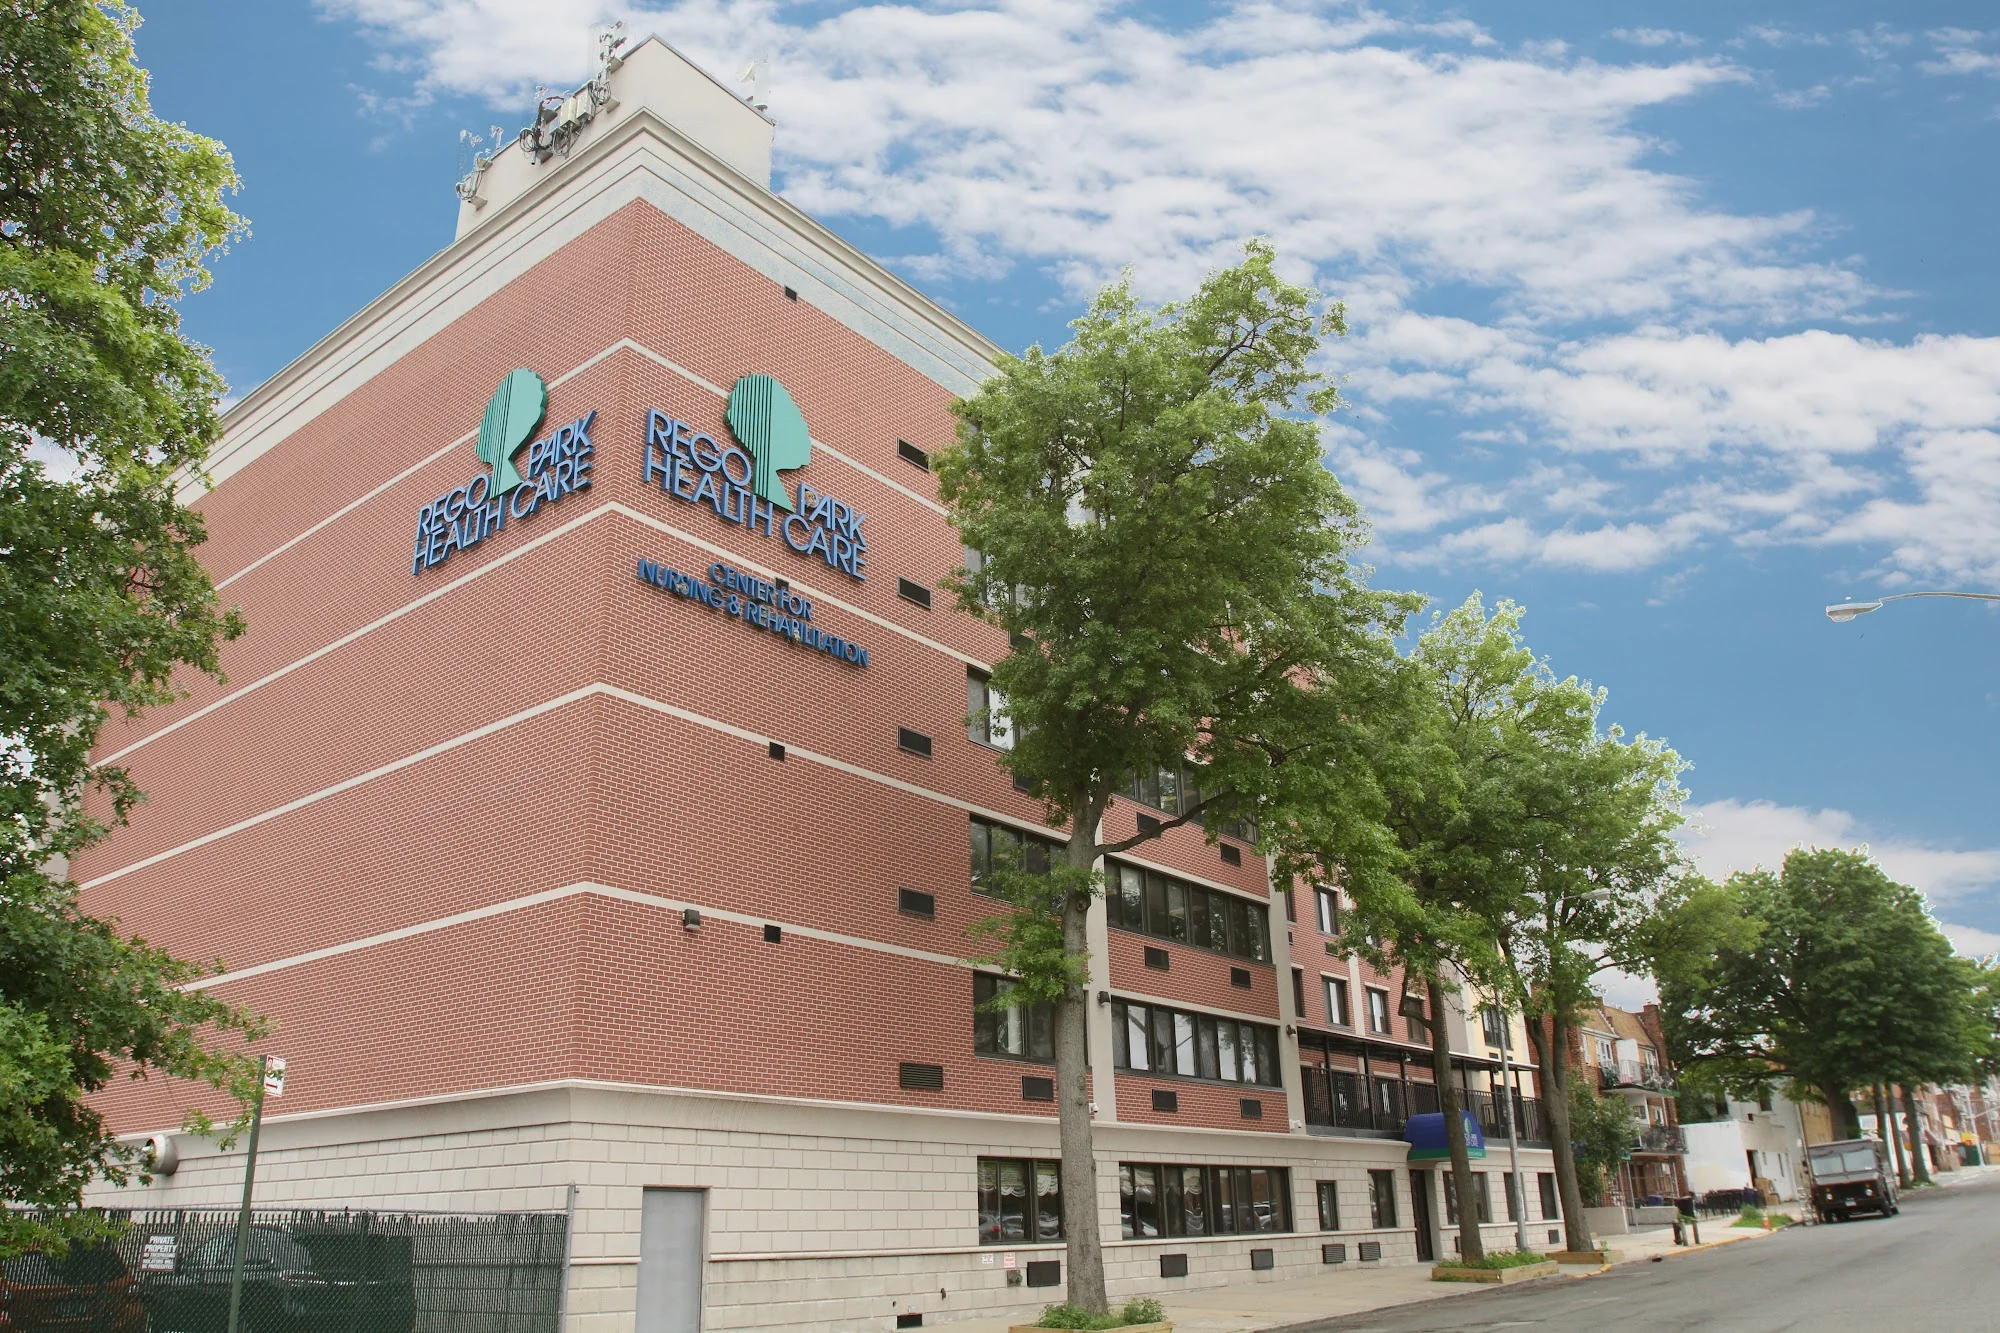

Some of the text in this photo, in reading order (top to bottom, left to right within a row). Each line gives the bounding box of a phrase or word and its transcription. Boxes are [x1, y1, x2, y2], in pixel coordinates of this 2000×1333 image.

[412, 446, 594, 576] HEALTH CARE
[416, 409, 597, 541] REGO PARK
[643, 445, 868, 581] HEALTH CARE
[646, 408, 868, 547] REGO PARK
[638, 558, 869, 668] NURSING & REHABILITATION
[708, 562, 813, 621] CENTER FOR
[144, 1244, 177, 1252] PROPERTY
[149, 1235, 175, 1244] PRIVATE
